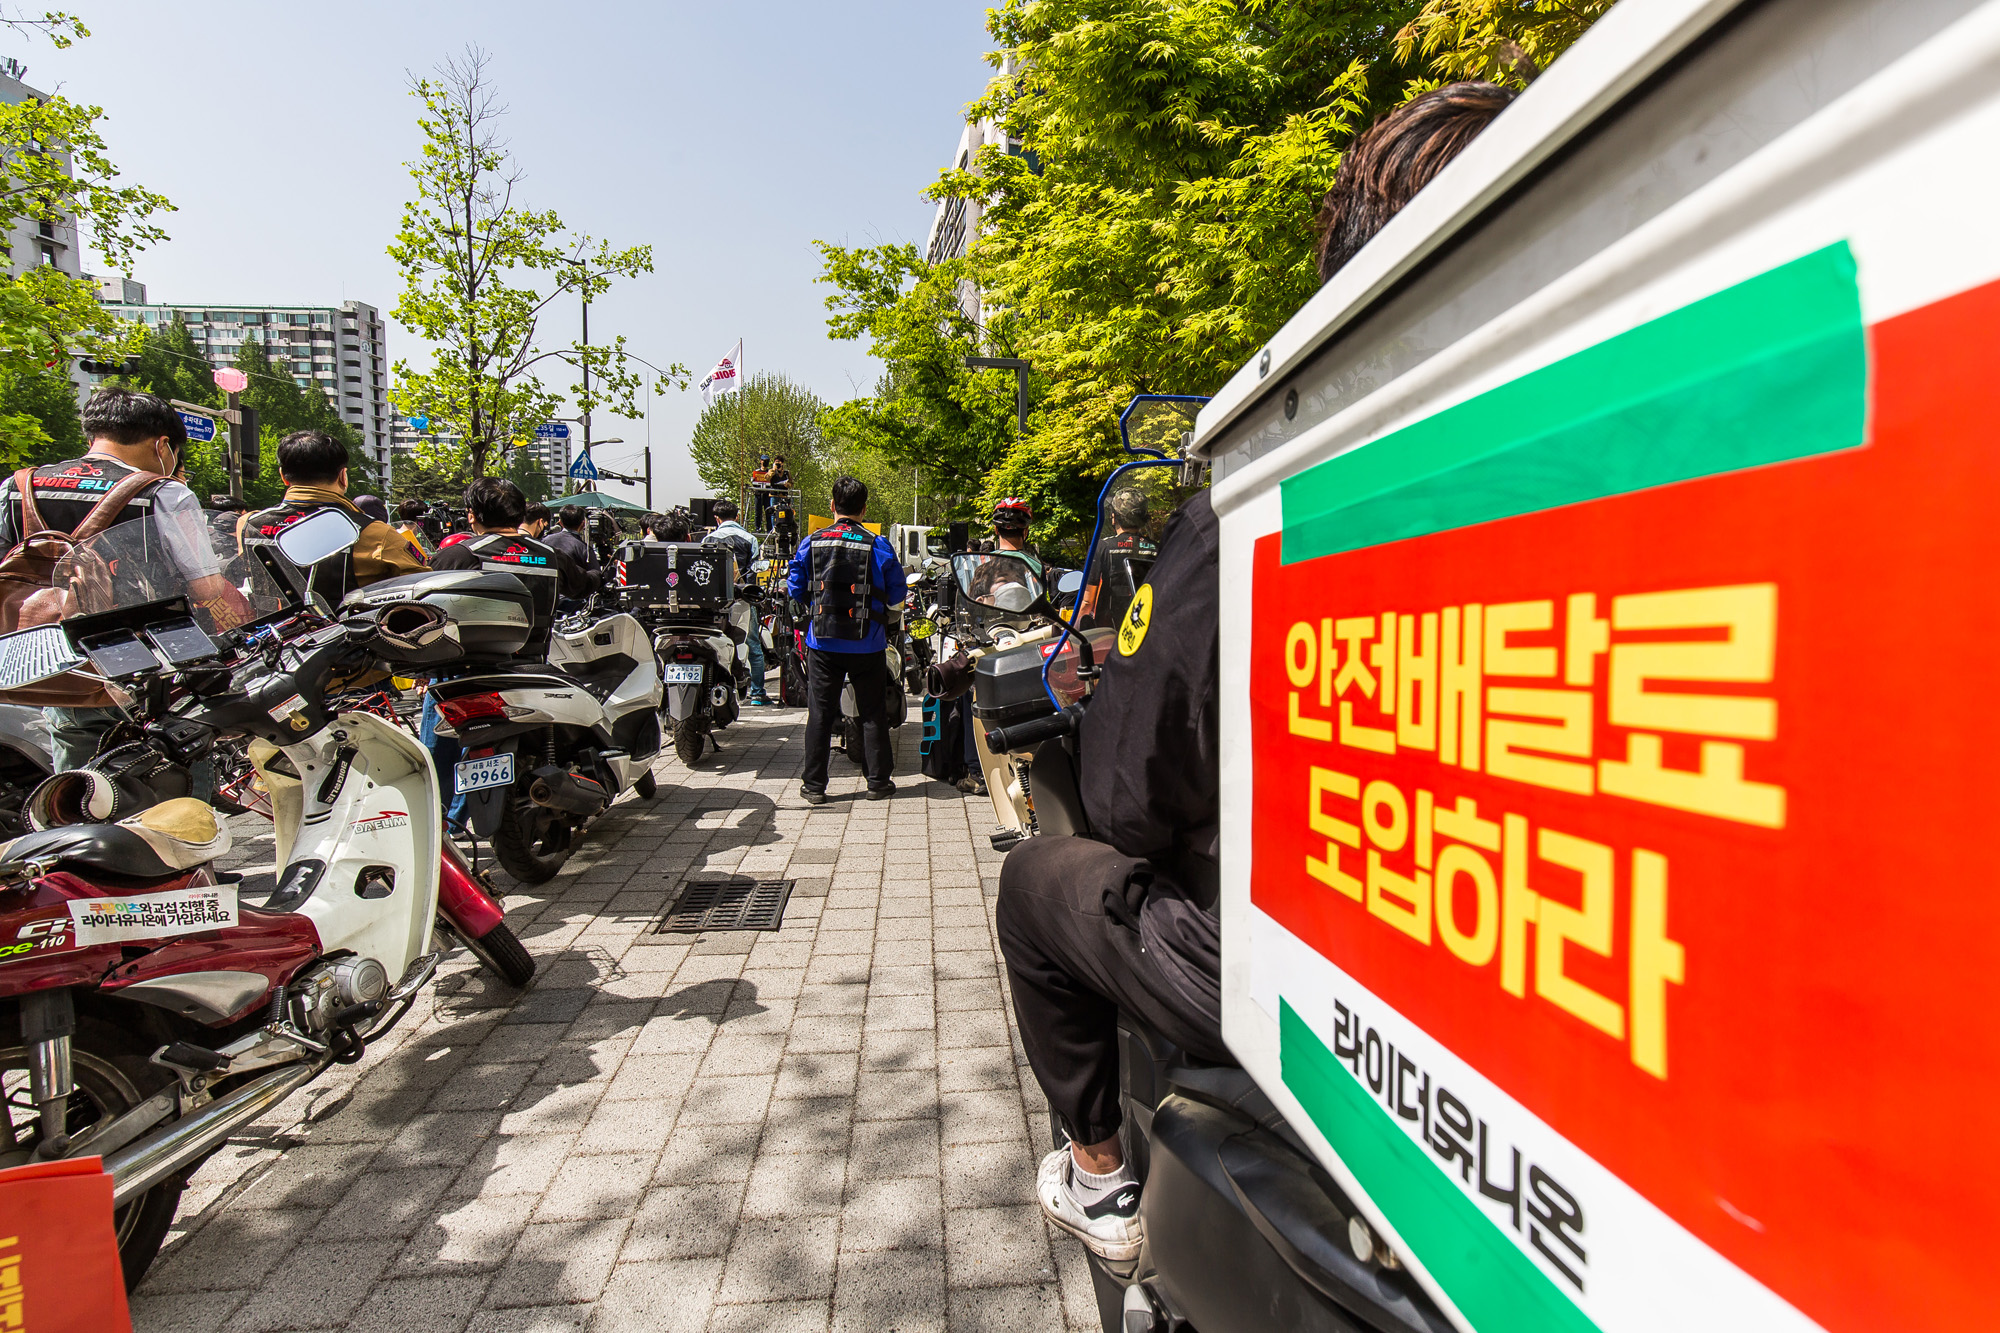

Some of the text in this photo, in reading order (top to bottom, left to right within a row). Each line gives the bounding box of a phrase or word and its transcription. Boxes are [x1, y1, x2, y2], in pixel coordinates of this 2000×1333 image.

[33, 476, 118, 491] 라이더유니
[675, 672, 700, 680] 4192
[1285, 582, 1786, 827] 안전배달료
[472, 762, 484, 770] 서울
[471, 766, 509, 785] 9966
[355, 817, 407, 834] DAELIM
[89, 899, 220, 914] 쿠팡이츠와 교섭 진행 중
[81, 911, 231, 927] 라이더유니온에 가입하세요
[1306, 765, 1685, 1080] 도입하라
[1333, 999, 1588, 1293] 라이더유니온
